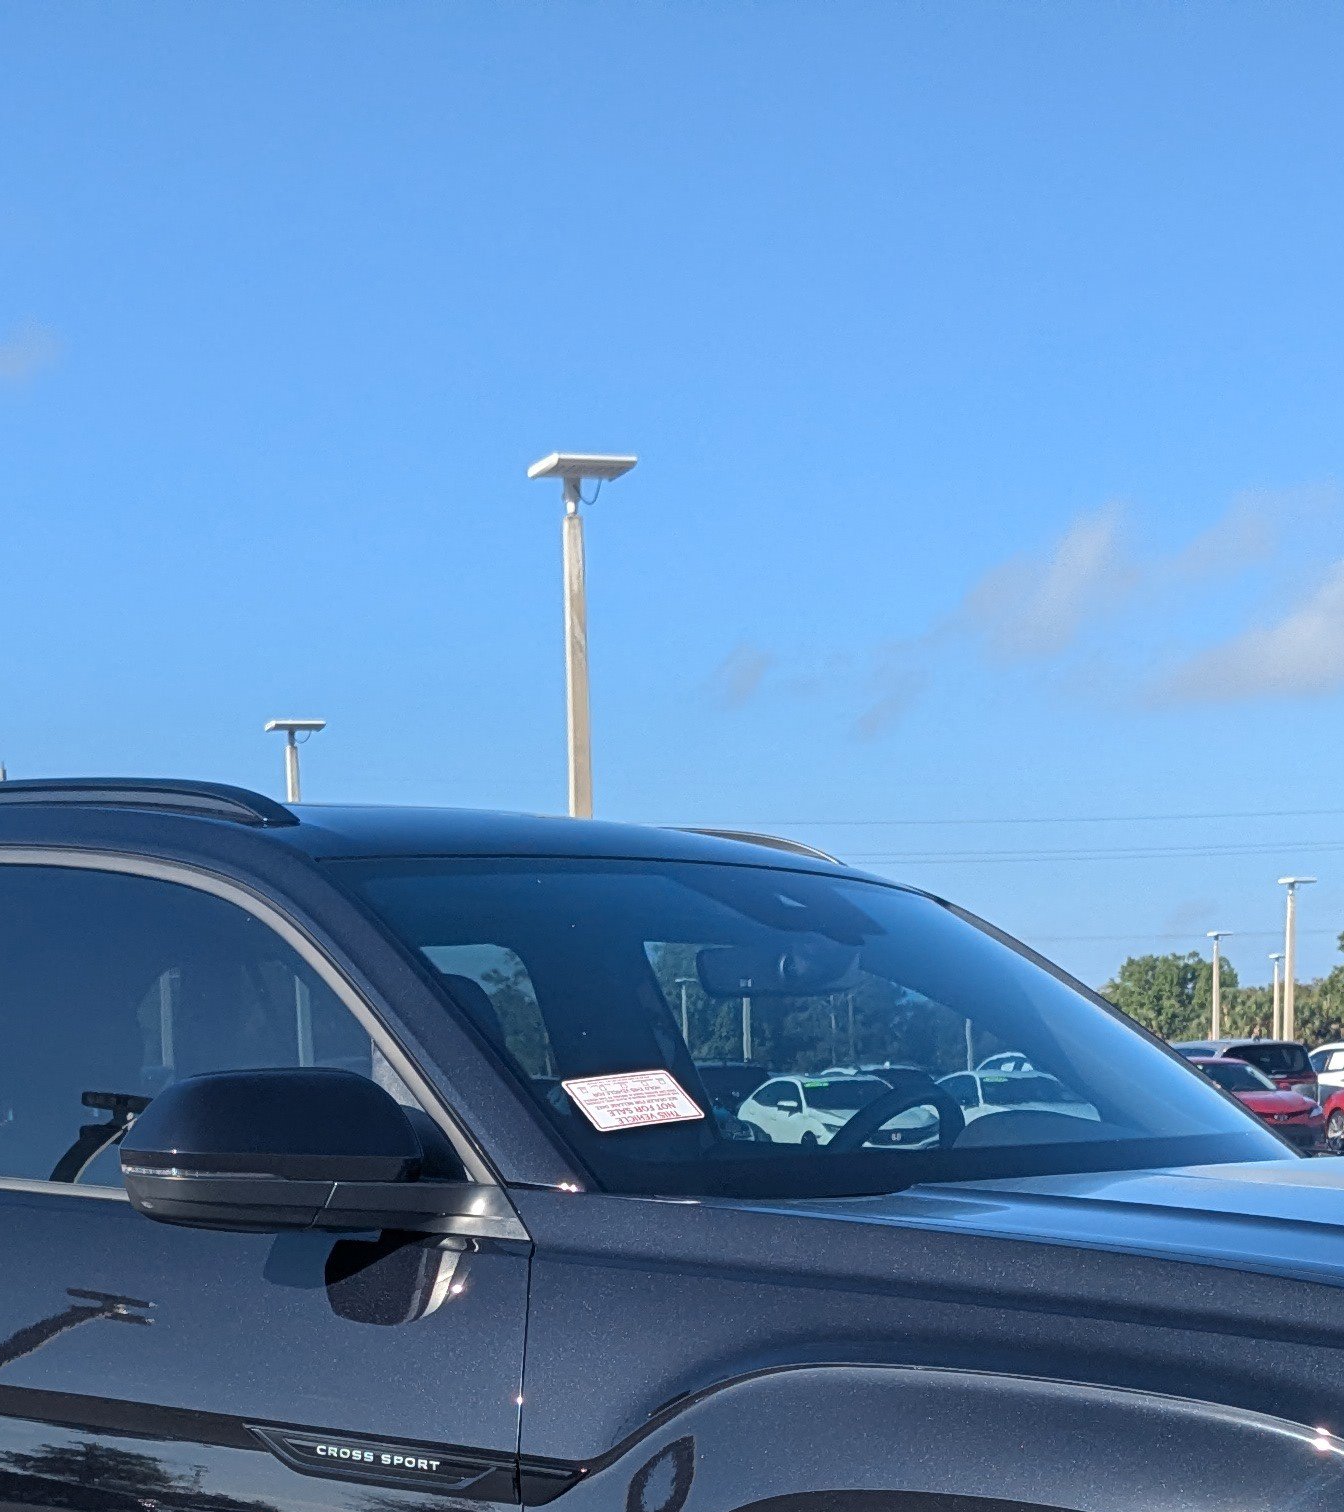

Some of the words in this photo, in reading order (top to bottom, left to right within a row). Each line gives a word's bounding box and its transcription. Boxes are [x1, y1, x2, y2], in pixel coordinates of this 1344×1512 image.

[632, 1104, 656, 1113] FOR
[653, 1101, 677, 1111] NOT
[605, 1106, 634, 1117] SALE
[655, 1109, 682, 1119] THIS
[614, 1112, 657, 1124] VEHICLE
[315, 1444, 374, 1463] CROSS
[380, 1453, 441, 1471] SPORT
